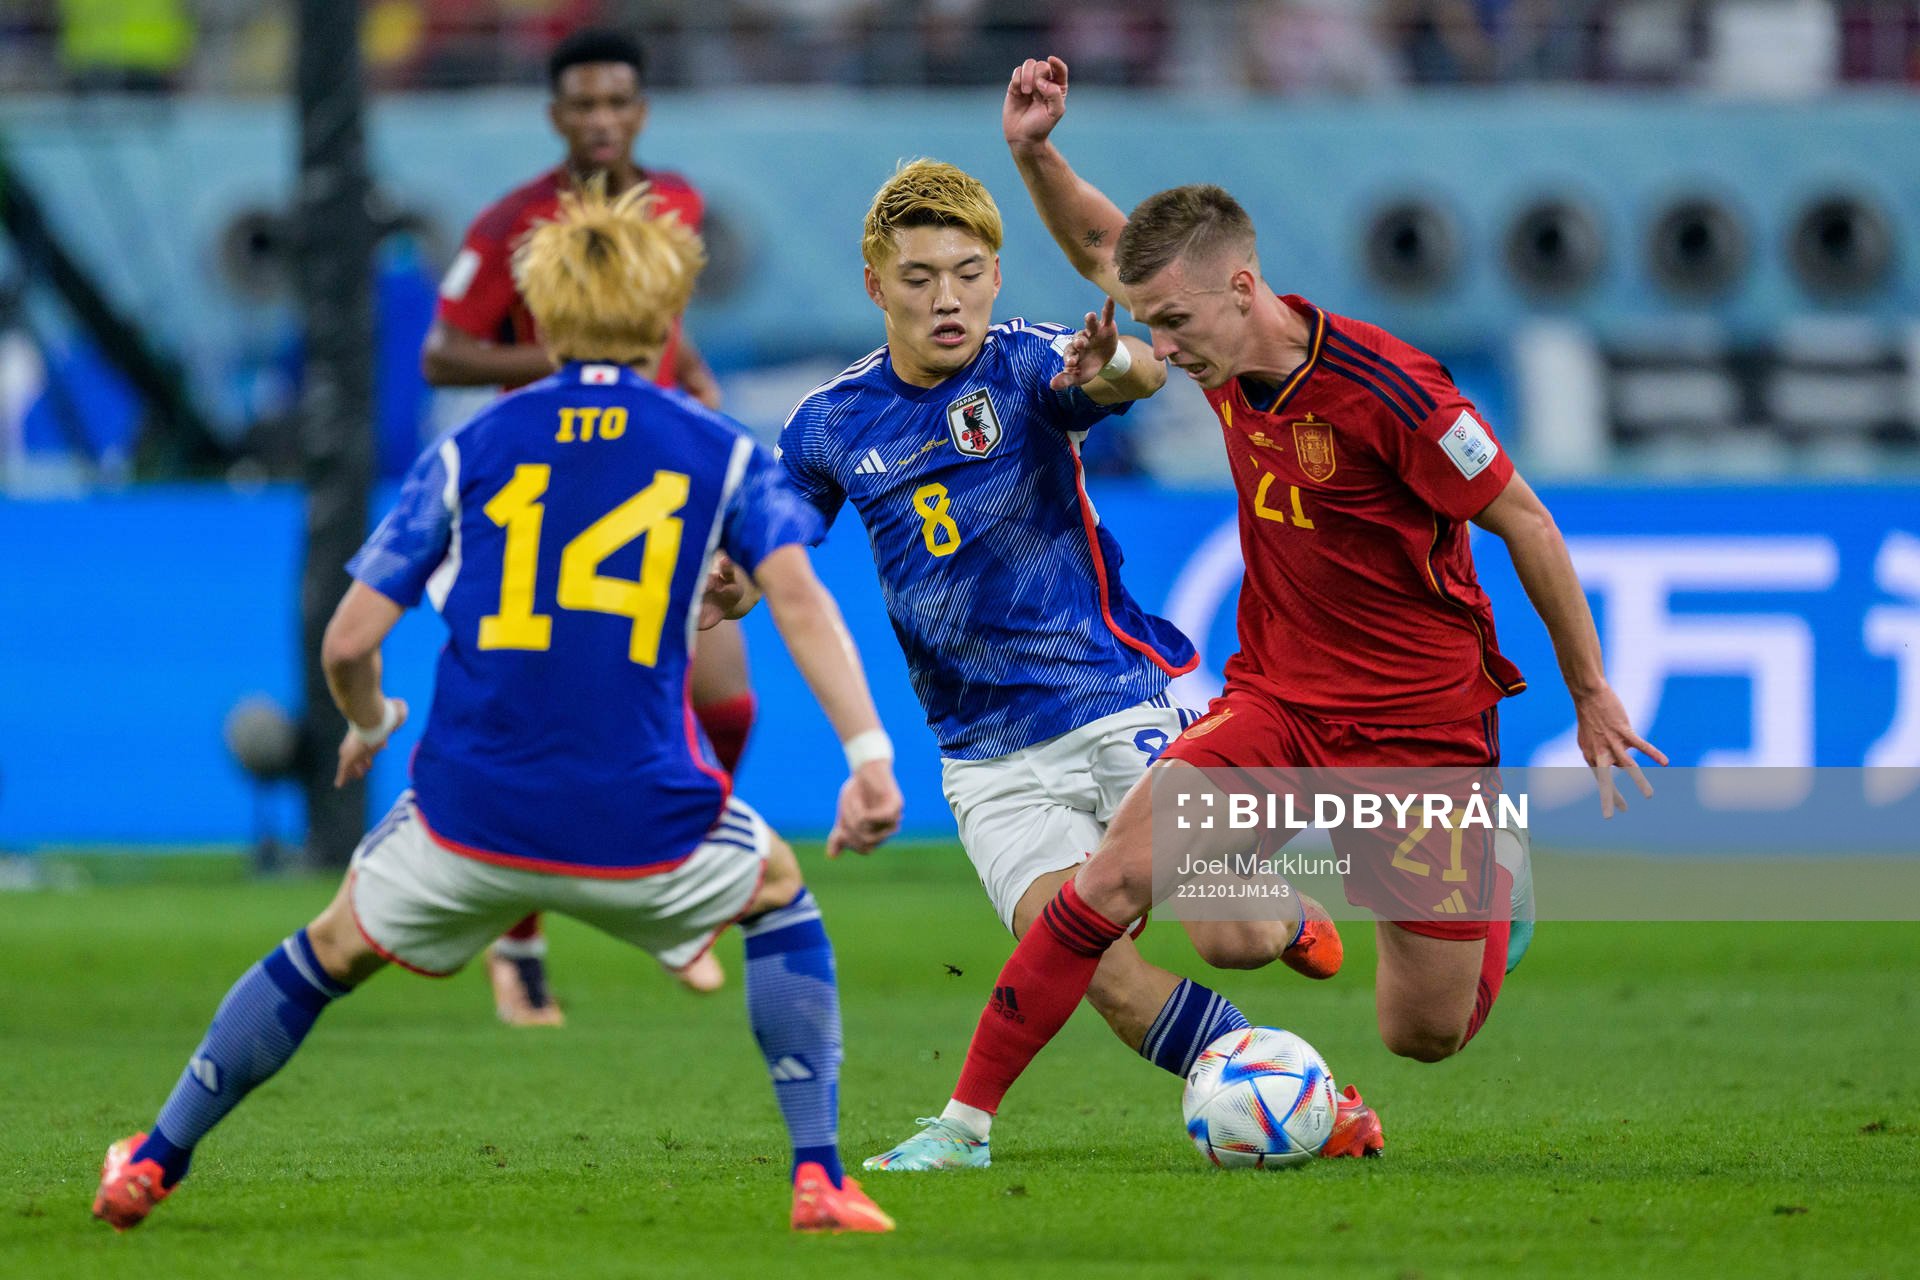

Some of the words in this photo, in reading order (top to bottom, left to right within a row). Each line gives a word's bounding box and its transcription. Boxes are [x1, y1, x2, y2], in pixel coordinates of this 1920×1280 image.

[555, 407, 628, 442] ITO
[955, 394, 977, 409] JAPAN
[970, 434, 990, 450] JFA
[912, 482, 961, 557] 8
[477, 463, 690, 668] 14
[1391, 805, 1468, 882] 21
